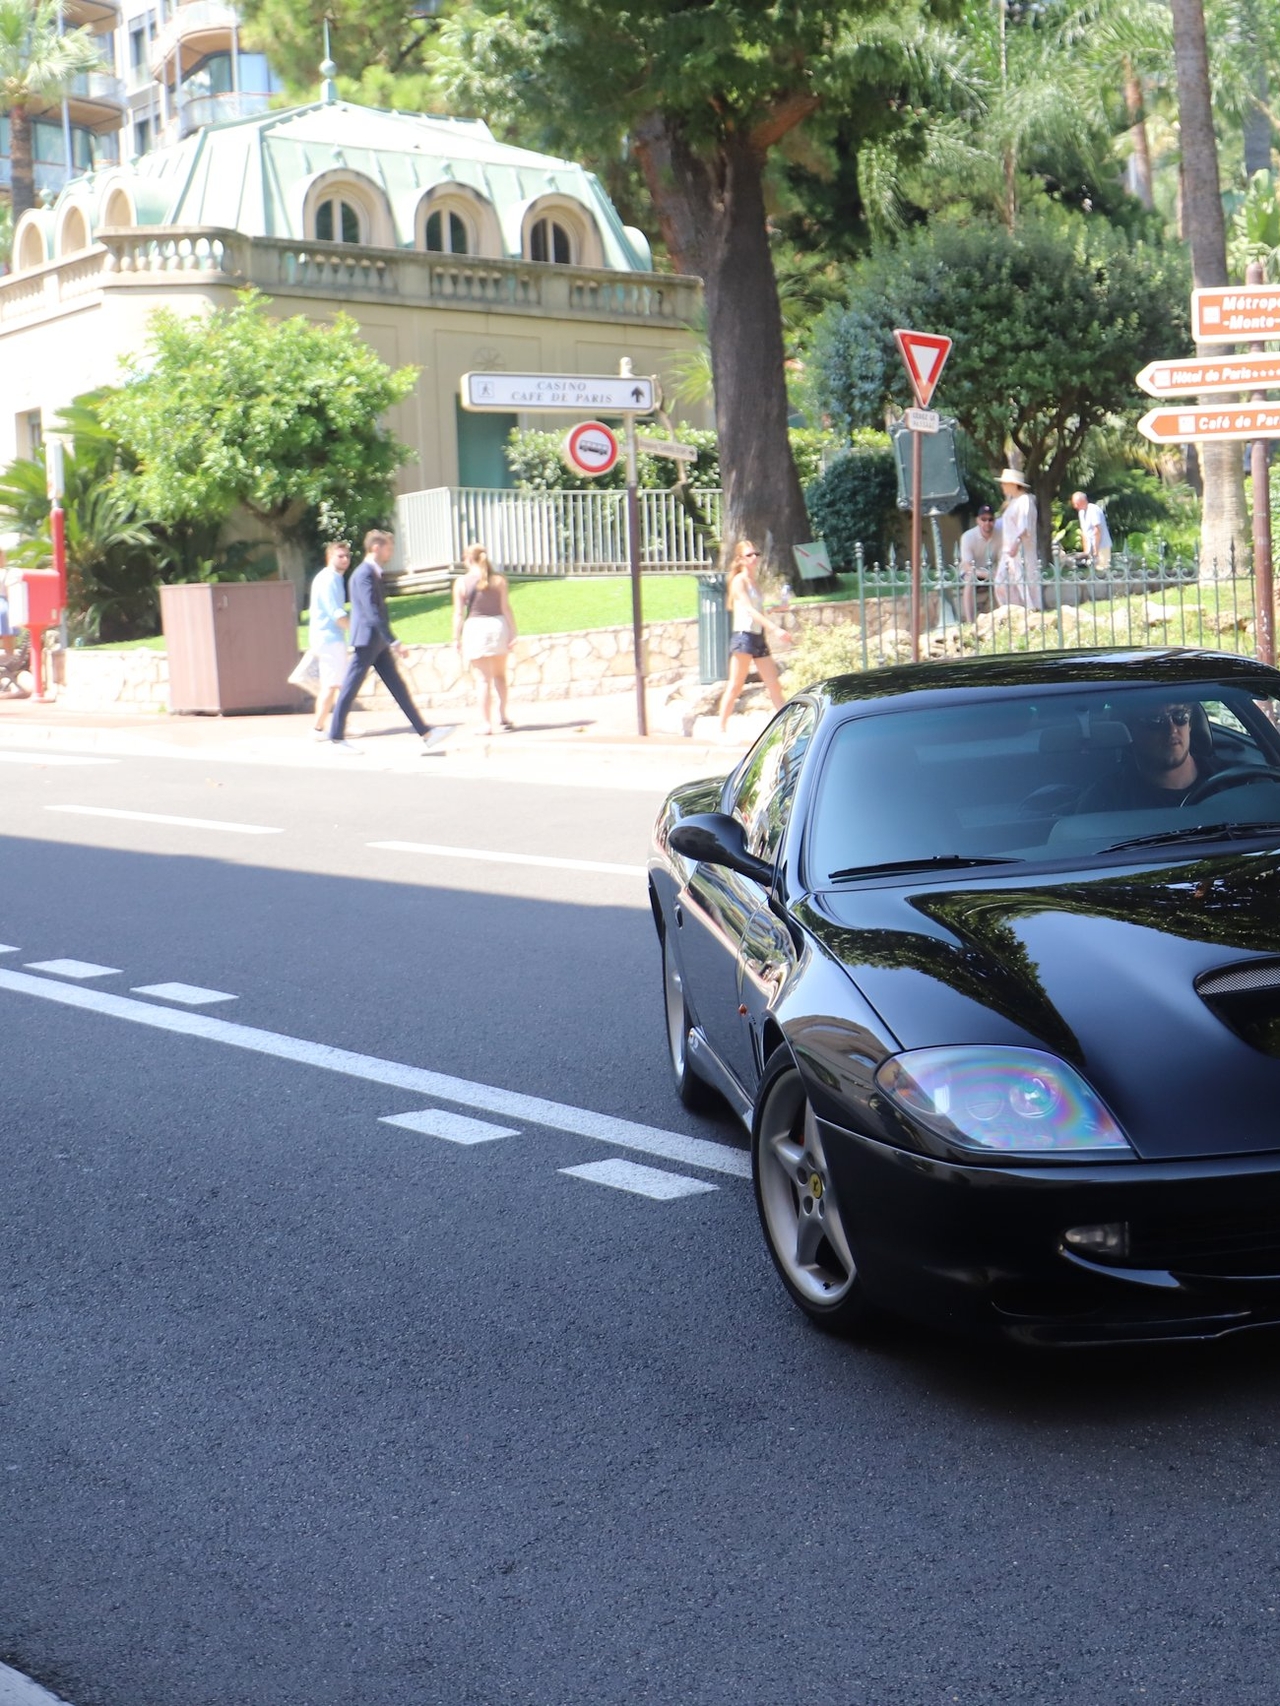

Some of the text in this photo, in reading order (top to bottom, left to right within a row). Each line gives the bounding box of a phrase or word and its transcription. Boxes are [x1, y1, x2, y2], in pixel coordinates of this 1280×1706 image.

[1172, 367, 1252, 384] Hôtel de Paris
[537, 381, 587, 392] CASINO
[511, 391, 613, 404] CAFE DE PARIS
[1199, 415, 1230, 430] Café
[1235, 415, 1251, 428] de
